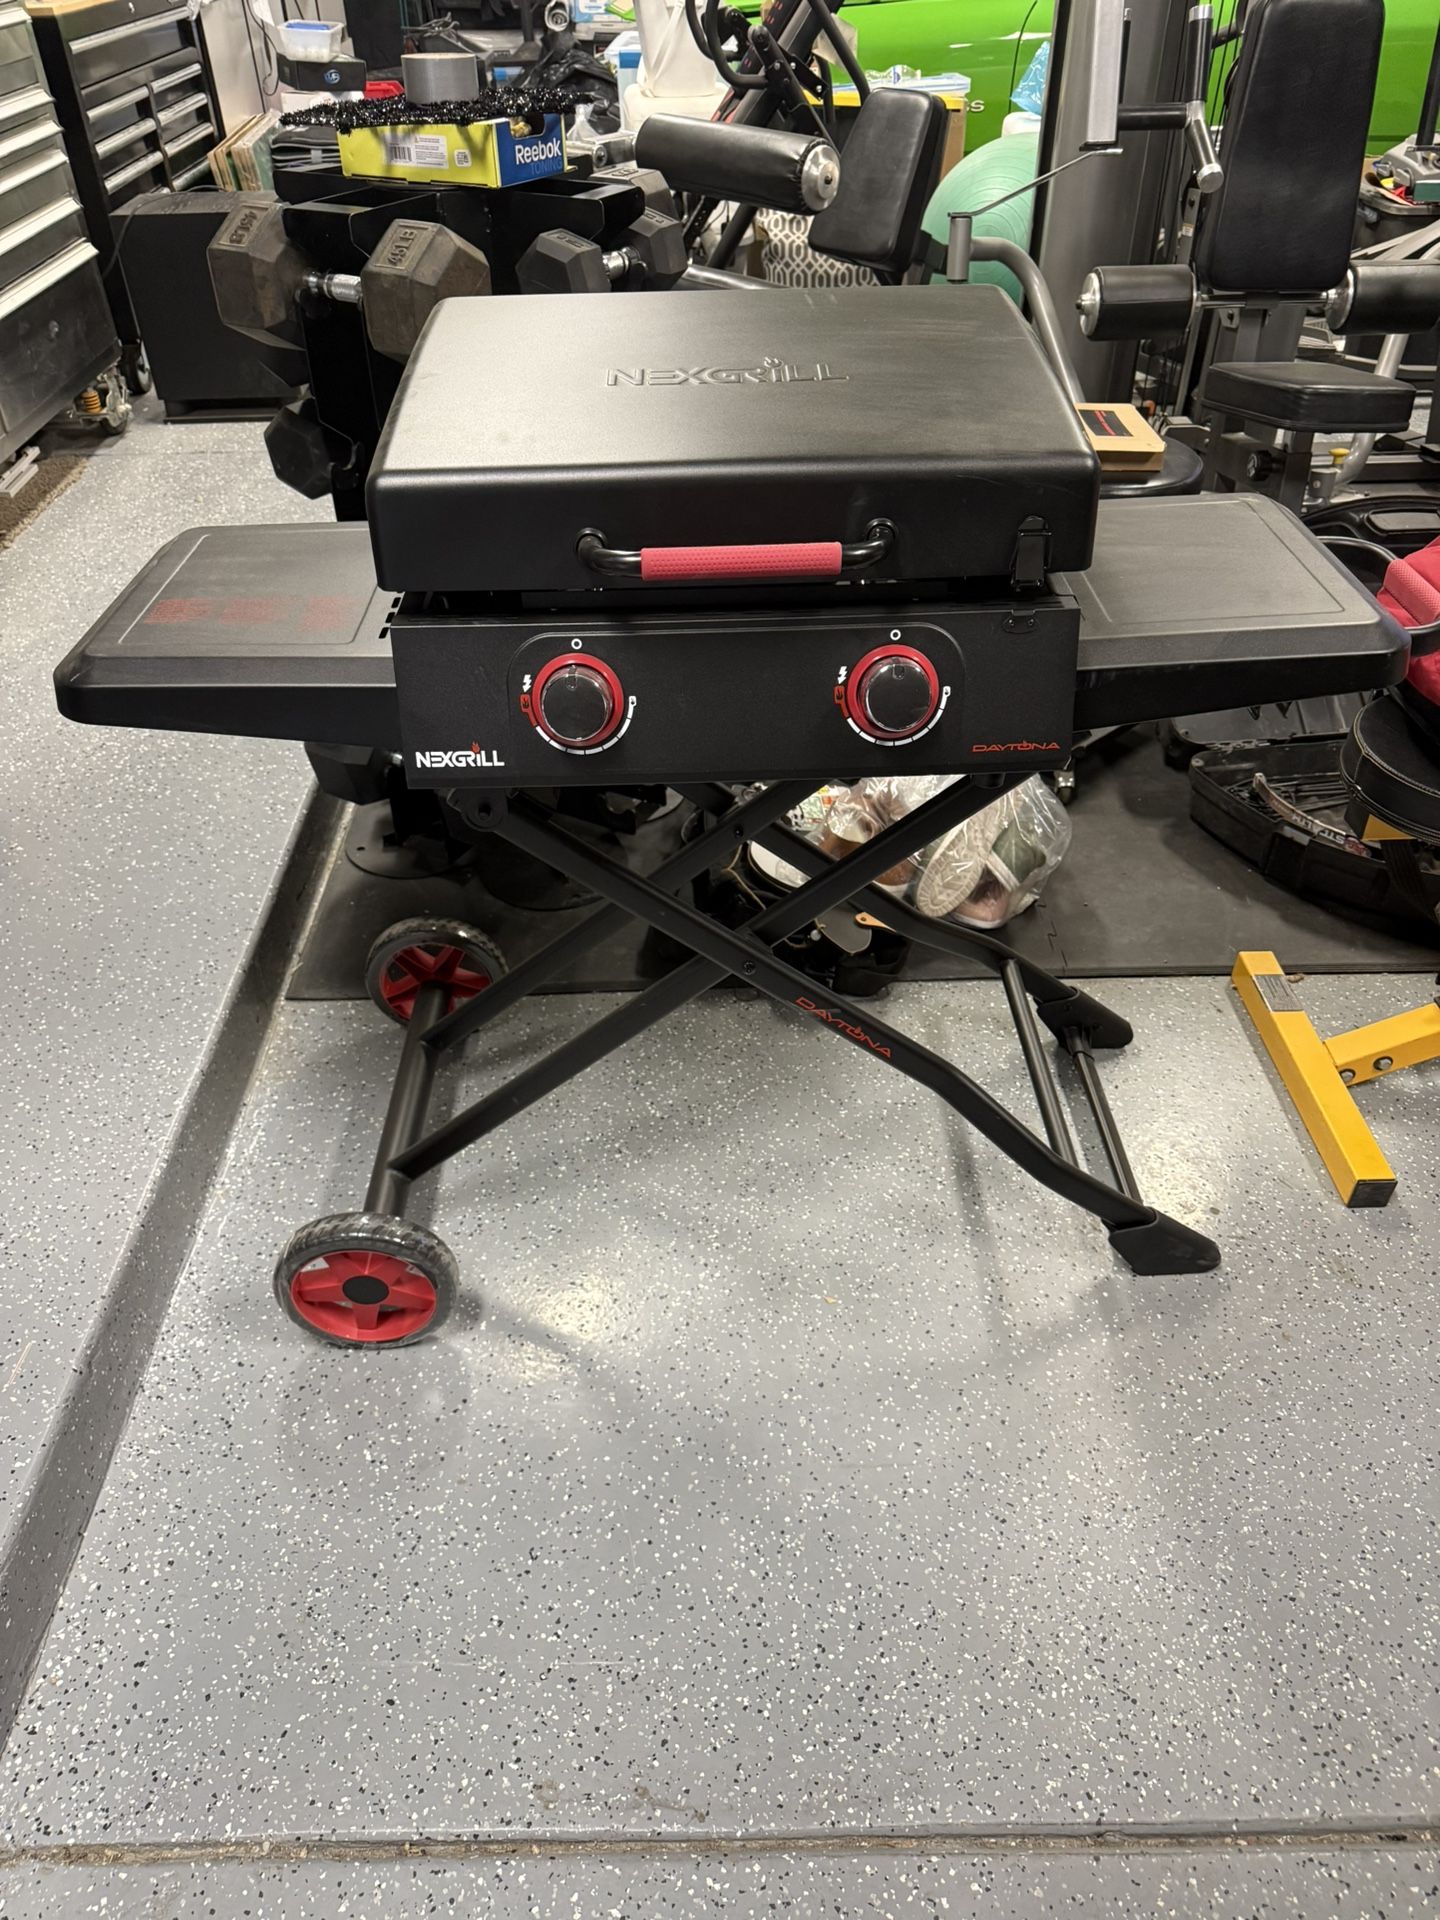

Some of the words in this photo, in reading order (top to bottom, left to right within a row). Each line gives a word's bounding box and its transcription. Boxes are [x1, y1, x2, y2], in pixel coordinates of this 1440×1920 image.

[515, 137, 562, 165] Reebok
[530, 156, 563, 176] TONING
[387, 229, 418, 266] 45LB
[606, 357, 850, 387] NEXGRILL
[415, 749, 505, 768] NEXGRILL
[971, 741, 1062, 753] DAYTONA
[795, 996, 892, 1059] DAYTONA
